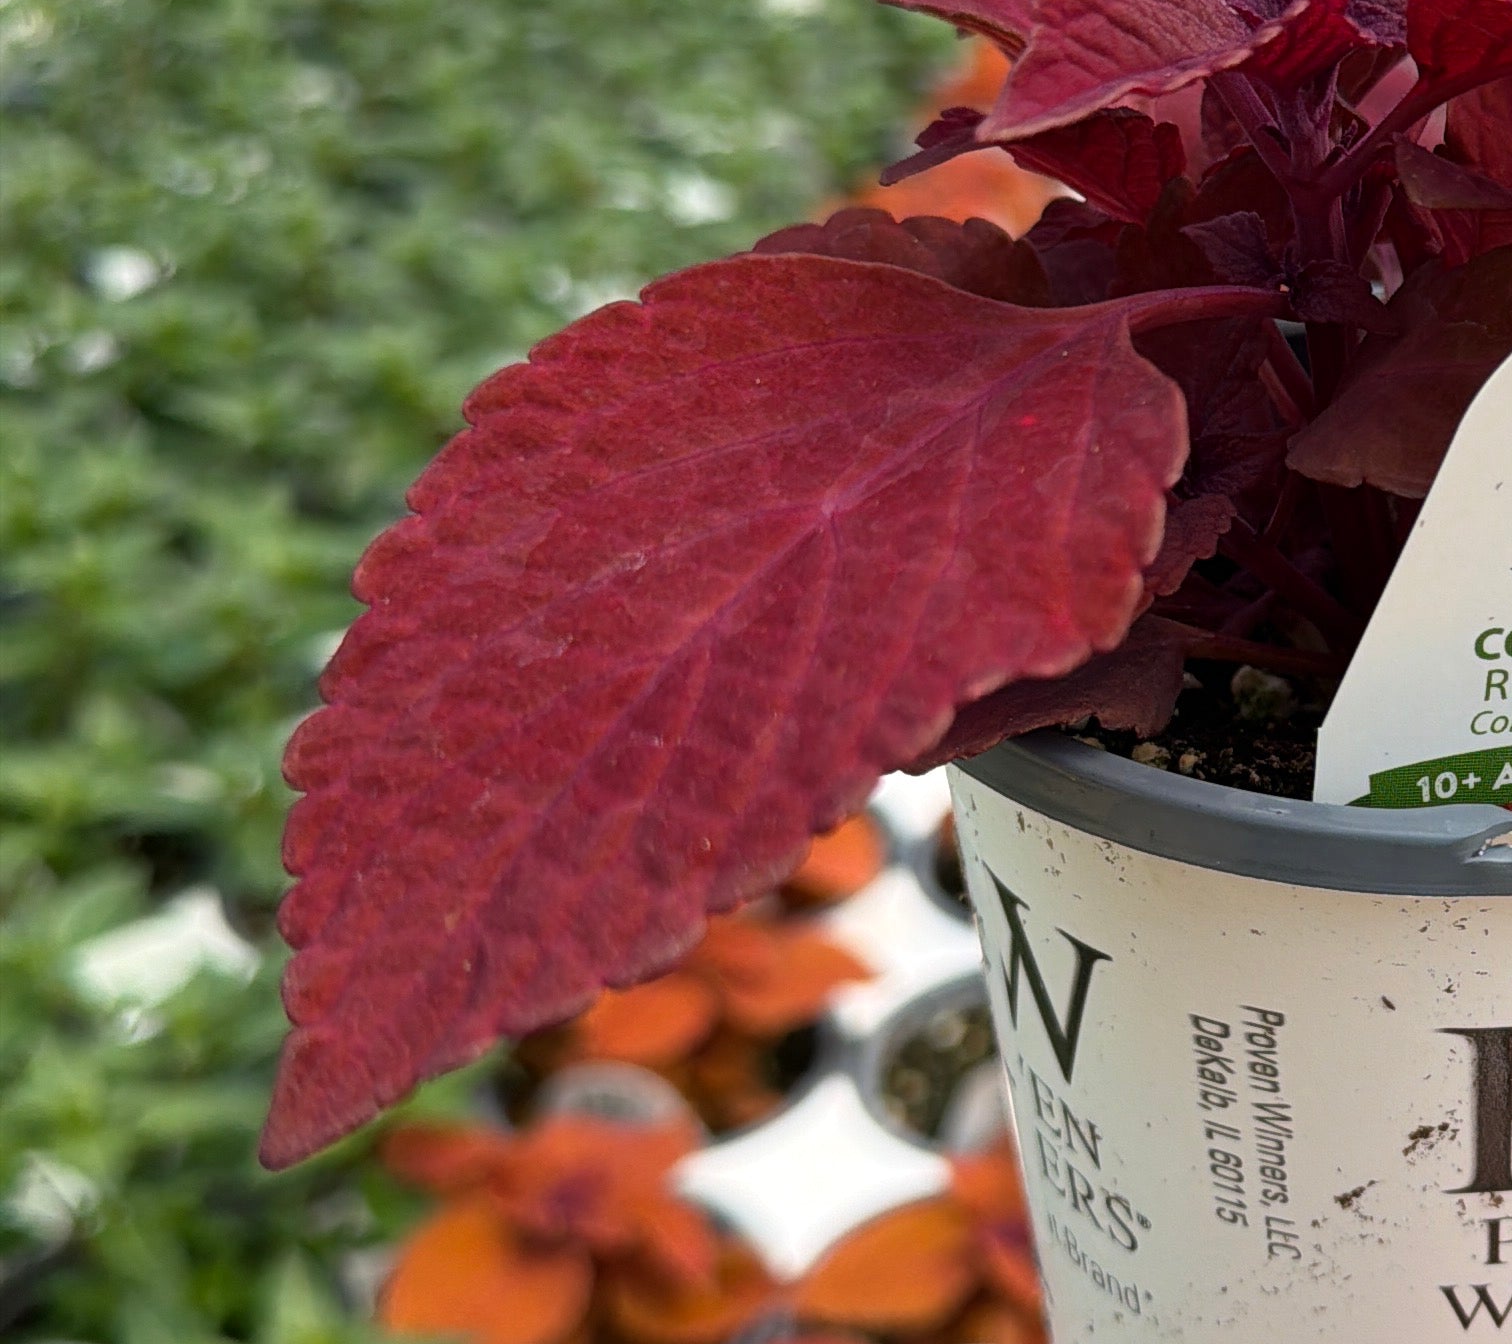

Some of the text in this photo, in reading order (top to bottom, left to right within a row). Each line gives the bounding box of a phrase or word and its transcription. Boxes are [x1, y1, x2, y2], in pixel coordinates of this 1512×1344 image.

[1416, 769, 1482, 803] 10+
[1188, 1012, 1249, 1229] DeKalb, IL 60115
[1240, 1004, 1302, 1261] Proven Winners, LLC
